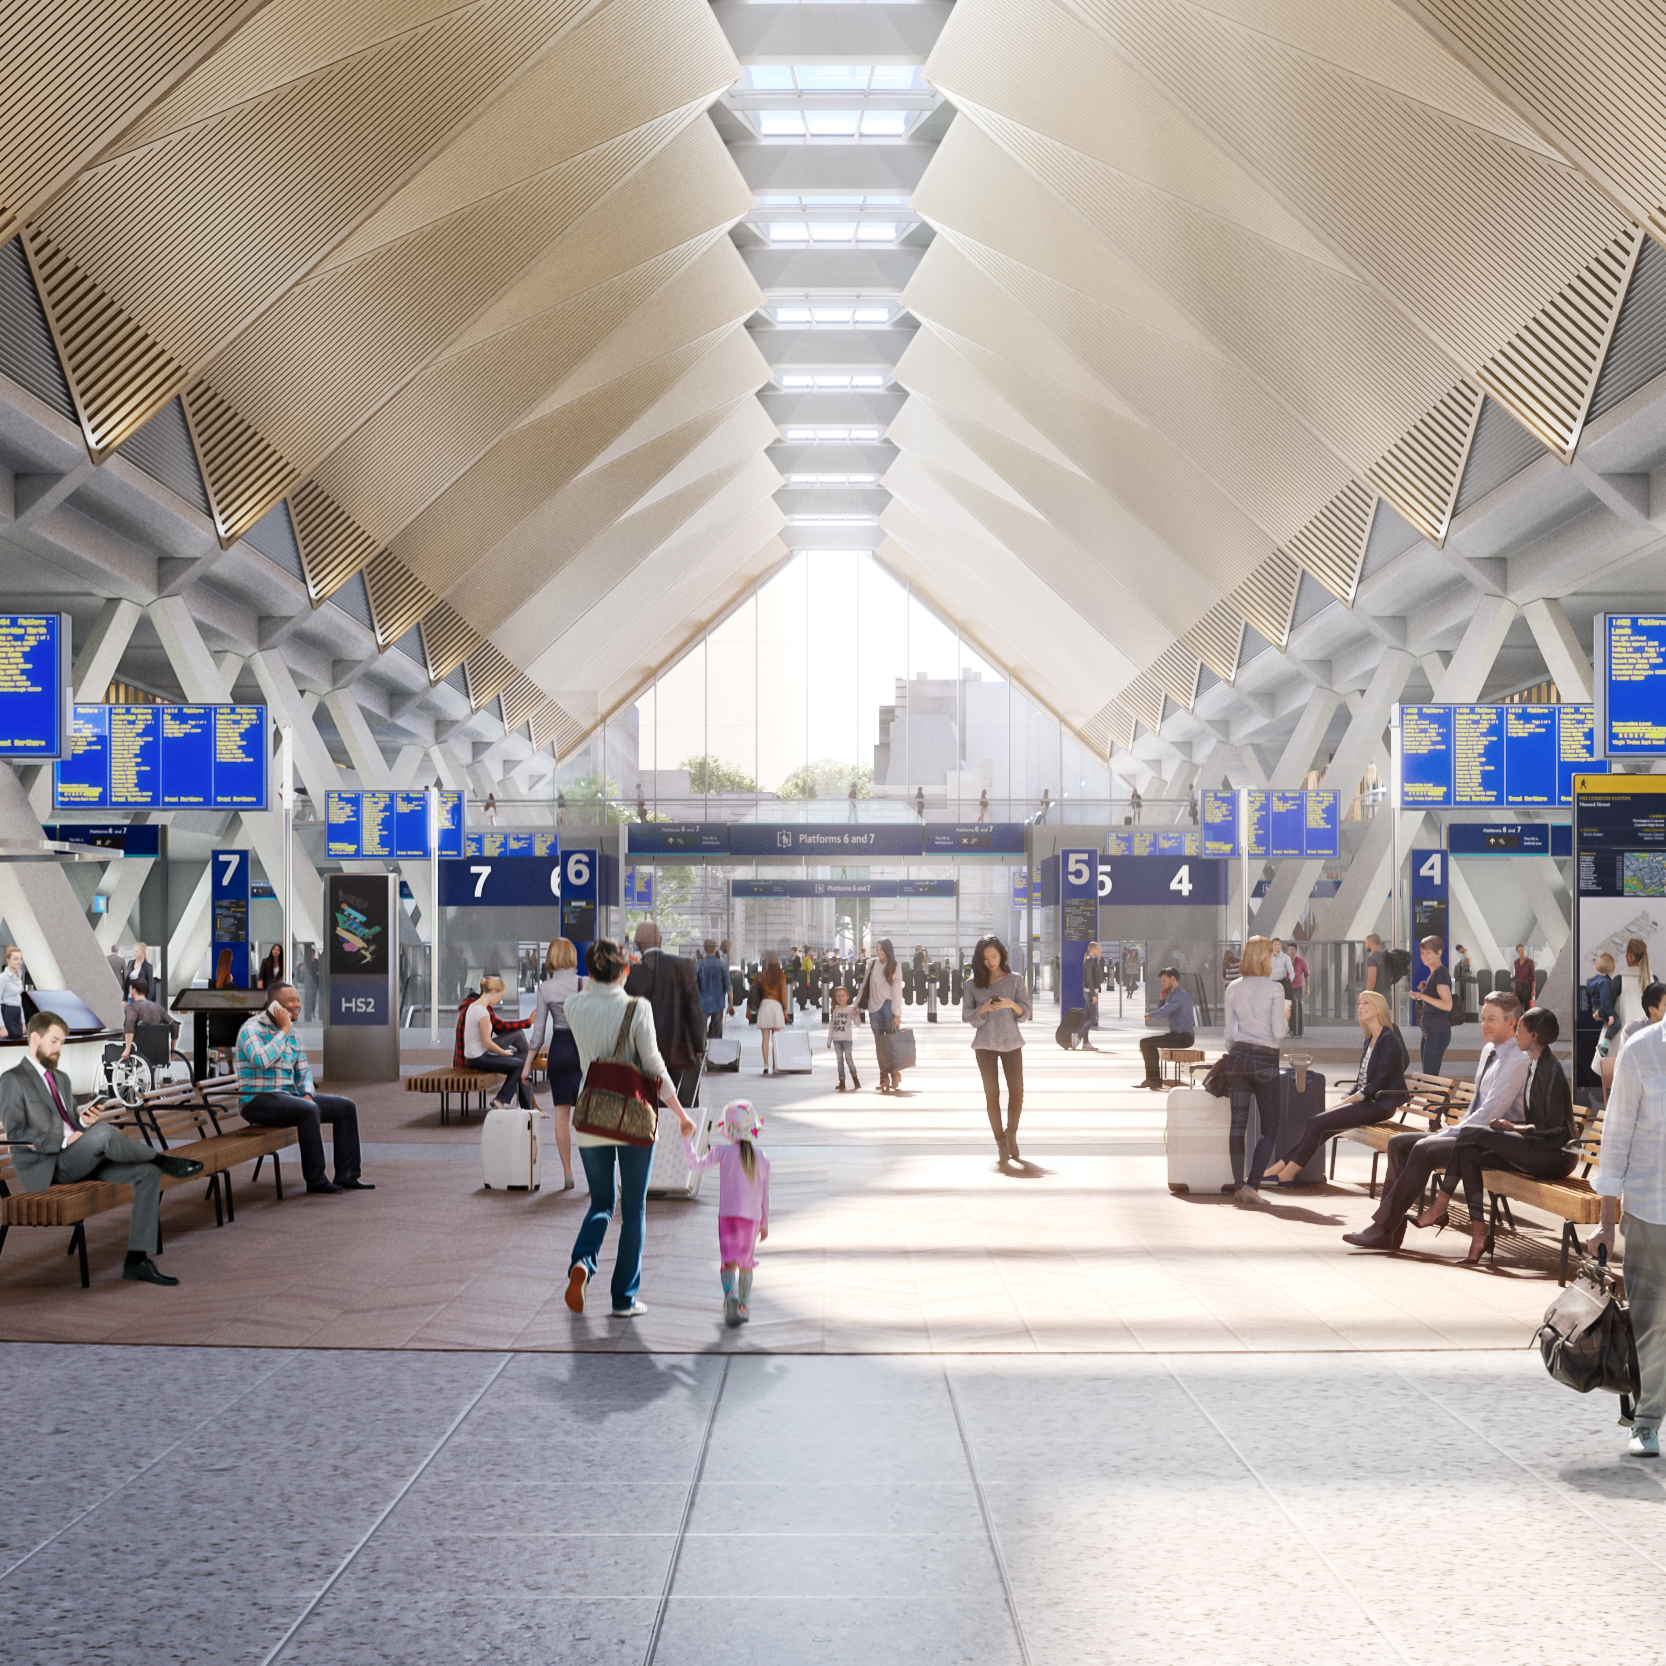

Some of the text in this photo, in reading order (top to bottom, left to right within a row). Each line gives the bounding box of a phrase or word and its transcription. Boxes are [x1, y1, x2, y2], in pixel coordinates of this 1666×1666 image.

[799, 834, 875, 844] Platforms 6 and 7
[219, 854, 240, 886] 7
[471, 866, 491, 897] 7
[567, 852, 590, 885] 6
[1067, 853, 1090, 885] 5
[1098, 865, 1193, 896] 5 4
[1419, 854, 1442, 885] 4
[341, 998, 375, 1012] HS2
